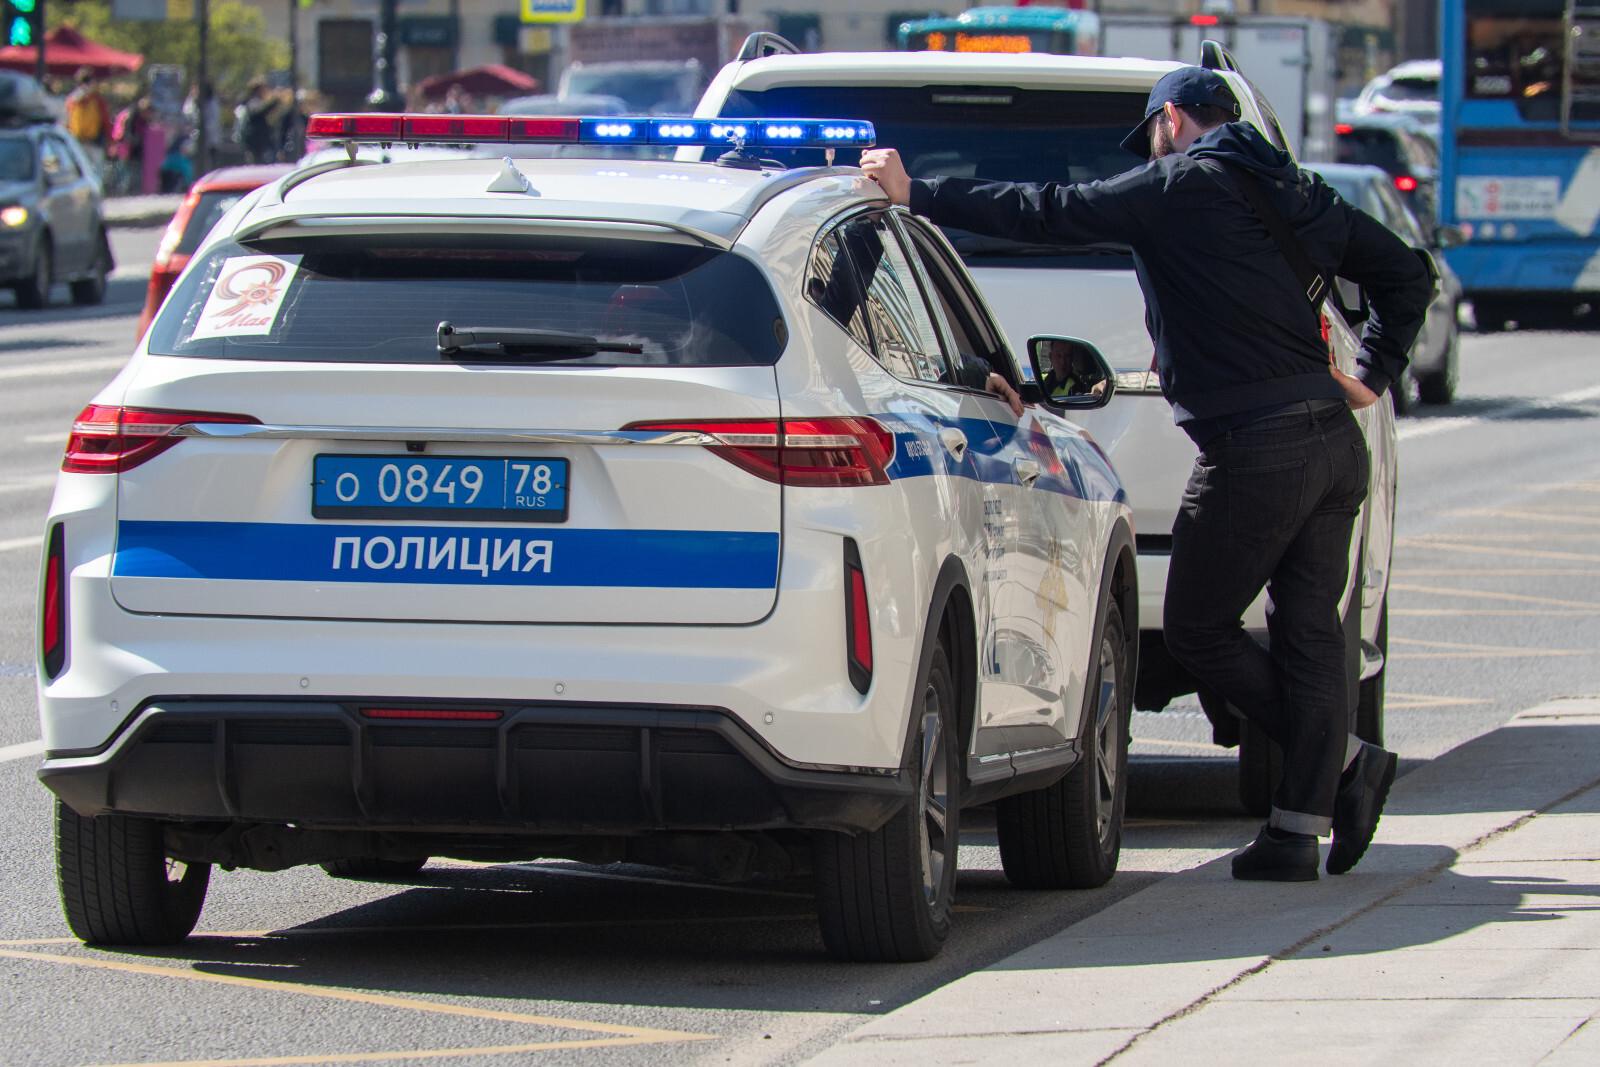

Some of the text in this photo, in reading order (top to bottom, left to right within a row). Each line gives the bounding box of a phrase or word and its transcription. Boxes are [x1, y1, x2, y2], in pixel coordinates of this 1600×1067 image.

[214, 313, 272, 330] Мая
[378, 463, 484, 504] 0849
[511, 464, 551, 495] 78
[515, 496, 546, 507] RUS
[332, 536, 553, 577] ПОЛИЦИЯ
